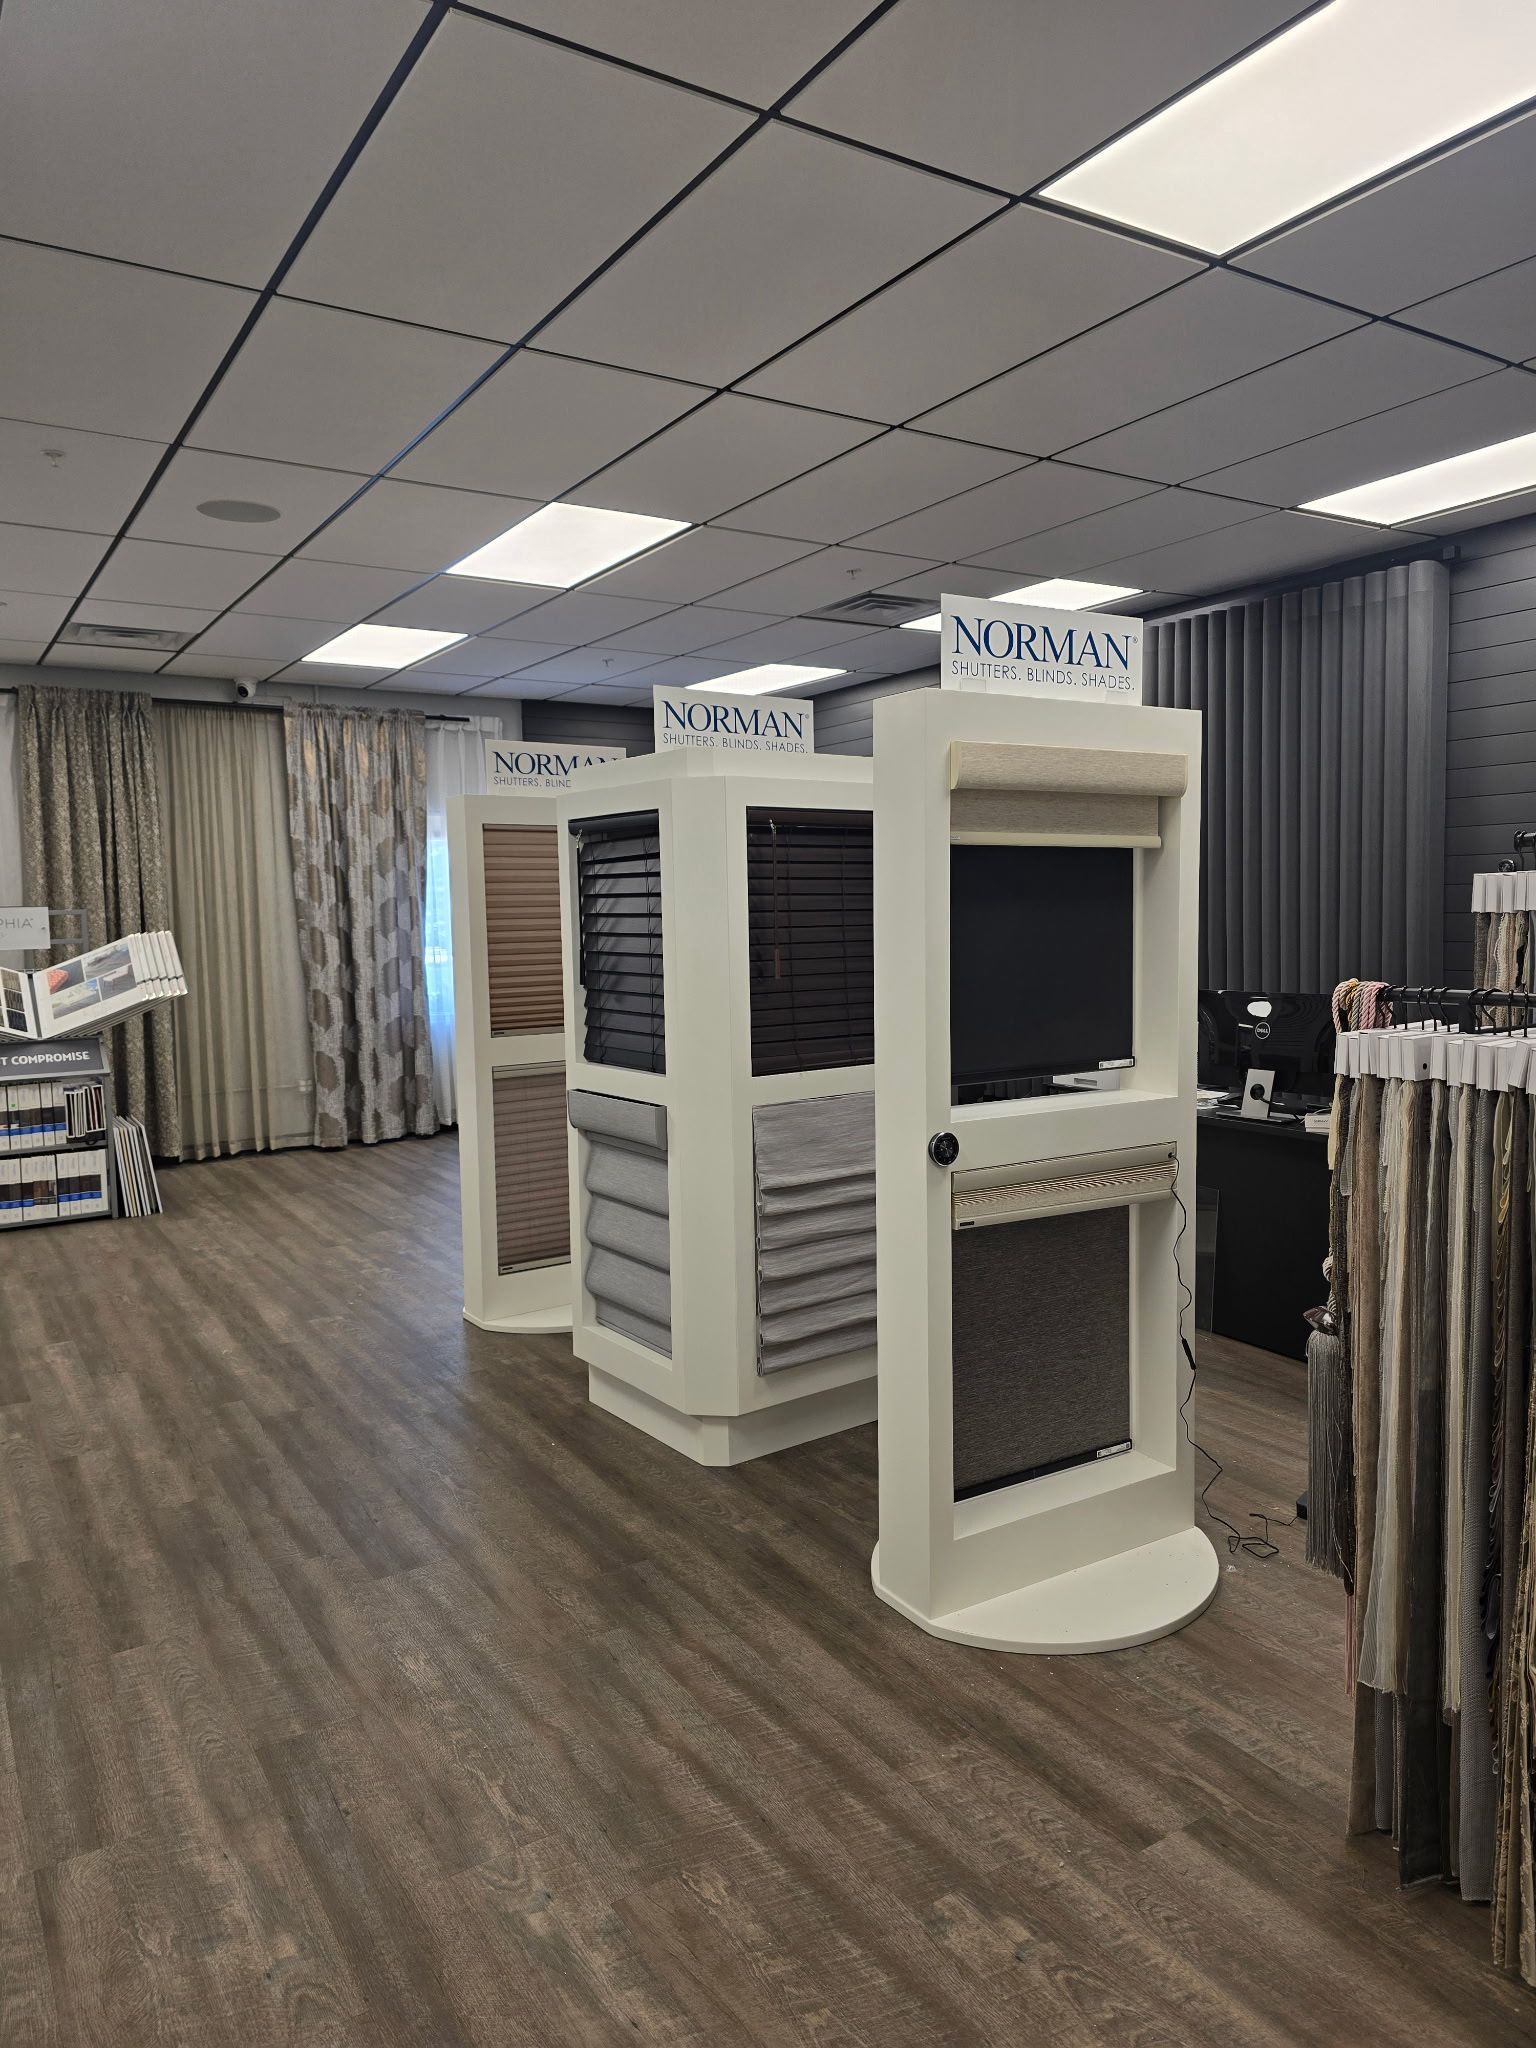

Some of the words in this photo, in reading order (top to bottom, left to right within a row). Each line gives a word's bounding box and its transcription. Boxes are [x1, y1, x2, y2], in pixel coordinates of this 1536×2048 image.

[951, 660, 1021, 681] SHUTTERS.
[1027, 667, 1077, 686] BLINDS.
[1081, 672, 1135, 691] SHADES.
[663, 733, 718, 747] SHUTTERS.
[722, 737, 762, 751] BLINDS.
[492, 751, 619, 776] NORM
[493, 776, 542, 787] SHUTTERS.
[11, 1050, 90, 1066] COMPROMISE
